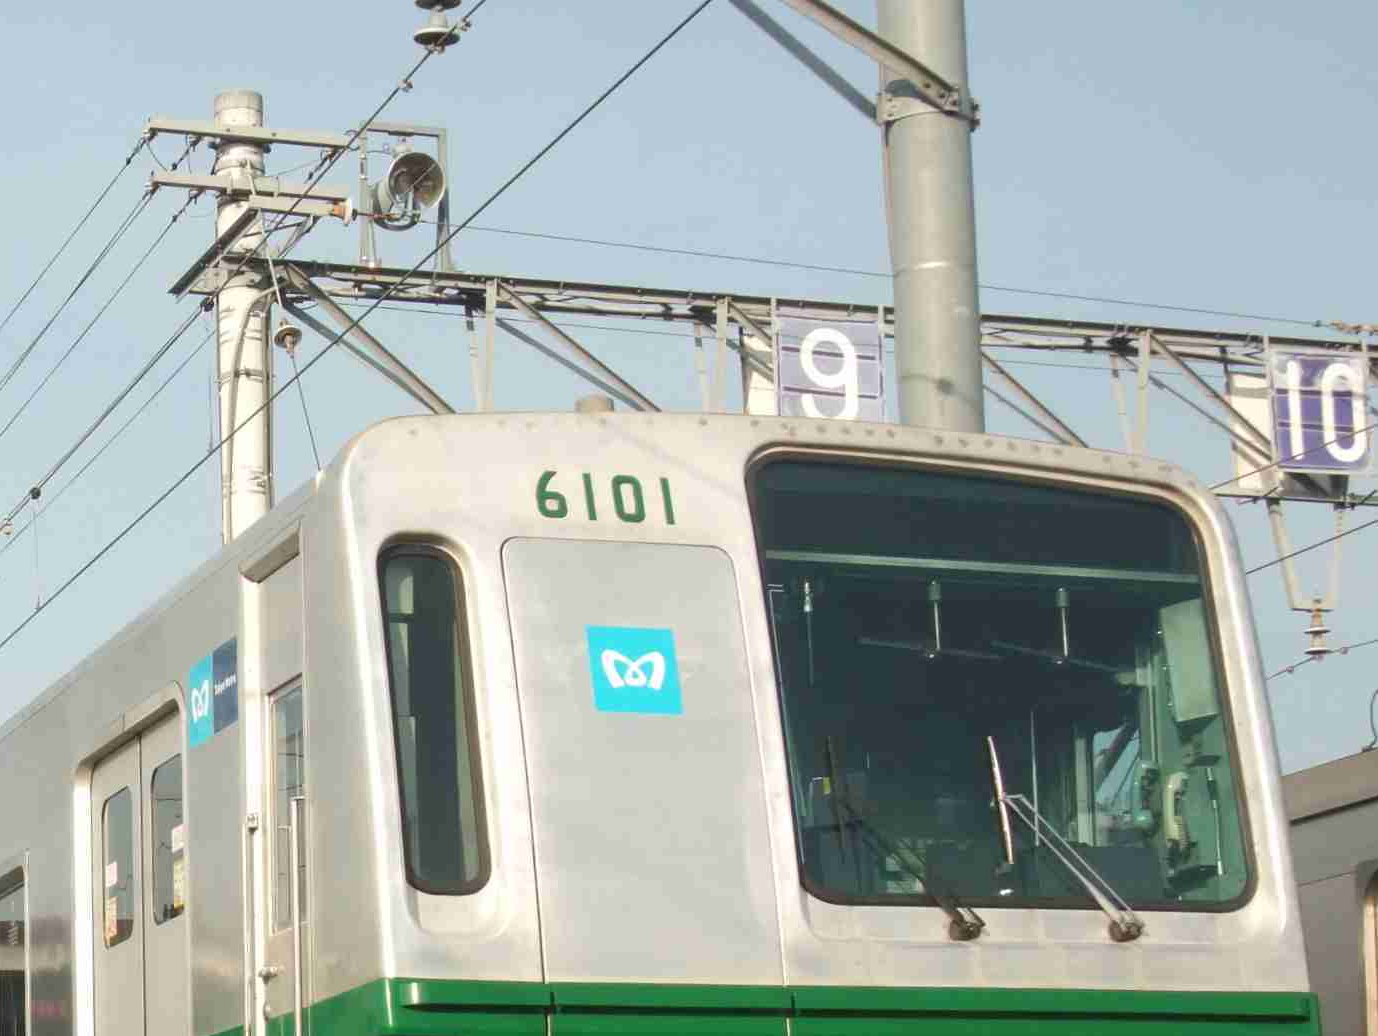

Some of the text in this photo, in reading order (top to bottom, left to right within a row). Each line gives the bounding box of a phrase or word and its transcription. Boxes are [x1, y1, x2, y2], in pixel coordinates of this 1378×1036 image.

[799, 328, 859, 419] 9
[1285, 359, 1369, 463] 10
[535, 470, 676, 526] 6101
